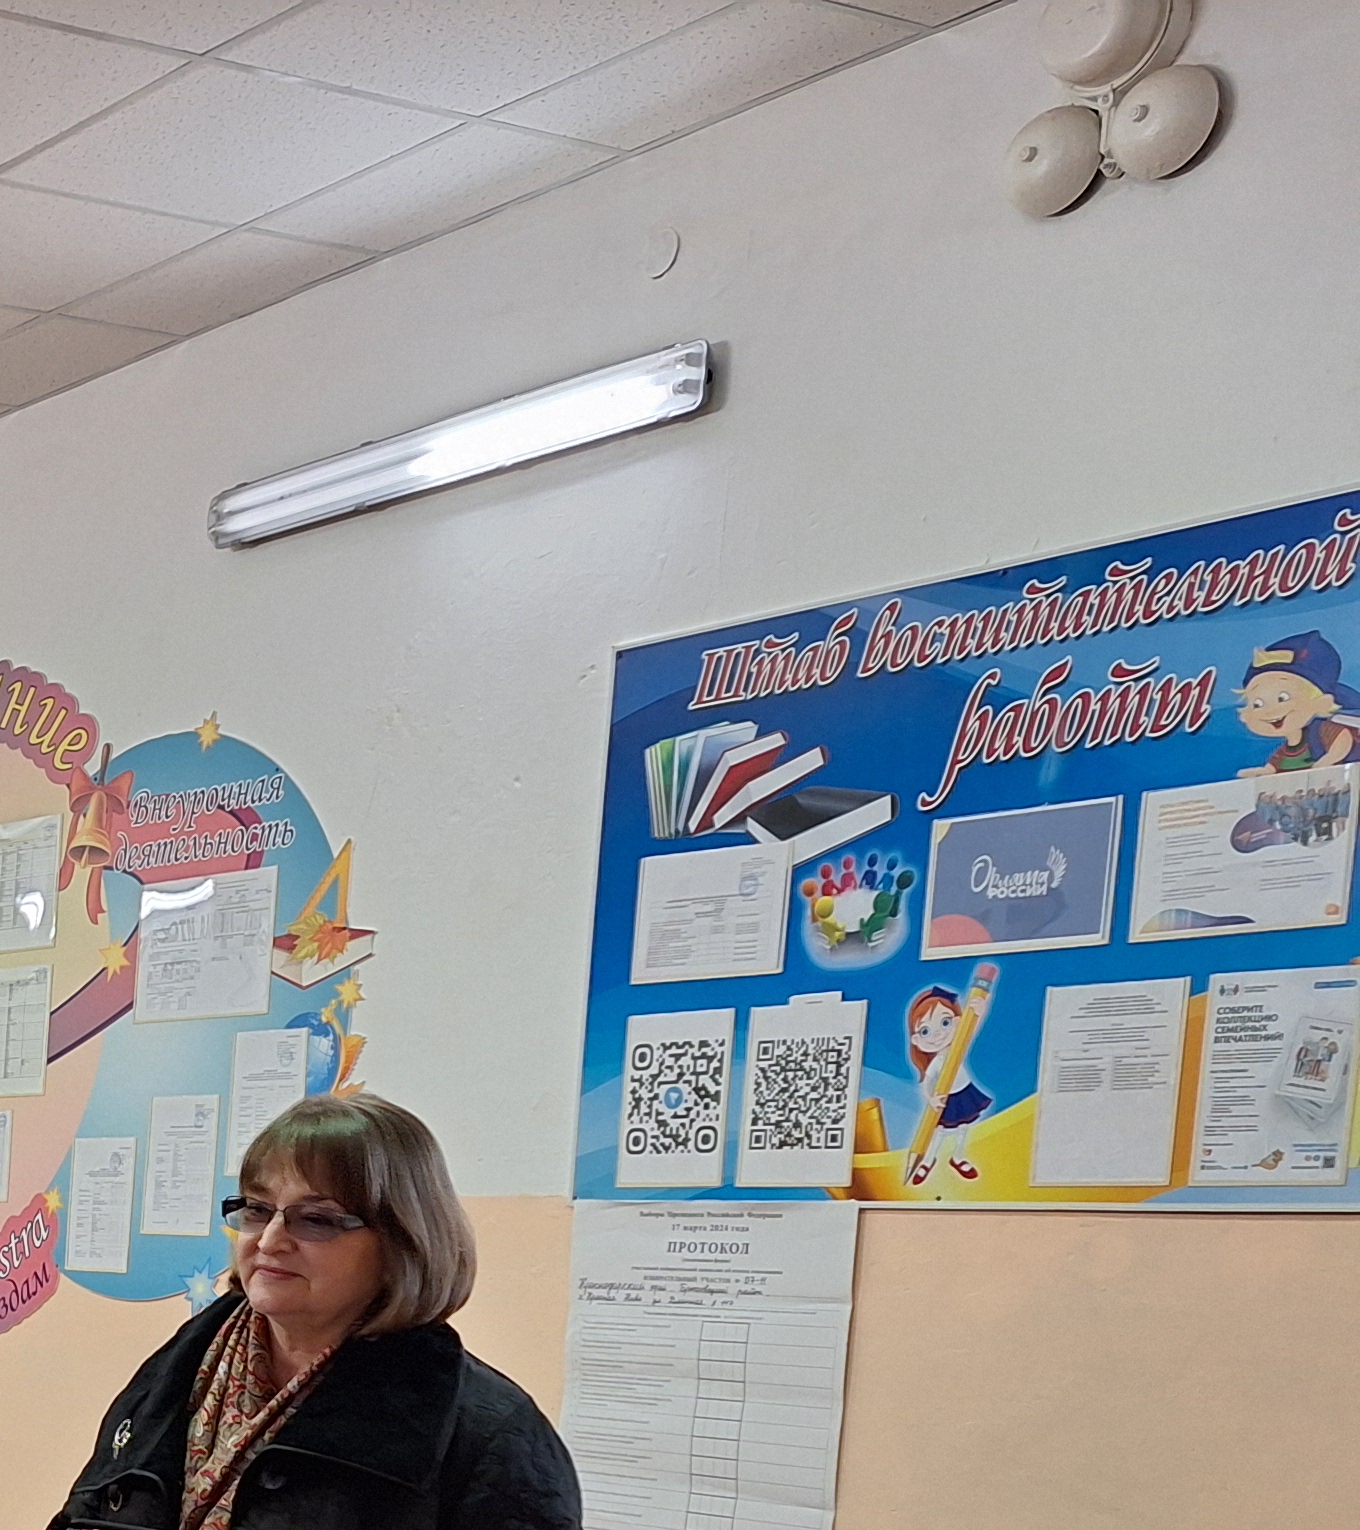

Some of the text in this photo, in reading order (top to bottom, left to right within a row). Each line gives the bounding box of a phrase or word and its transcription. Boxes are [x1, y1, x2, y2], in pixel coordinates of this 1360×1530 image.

[688, 510, 1360, 711] Штаб воспитательной
[917, 657, 1217, 811] работы
[130, 774, 283, 833] Внеурочная
[114, 819, 295, 872] деятельность
[988, 884, 1048, 899] РОССИИ
[1217, 1004, 1264, 1015] СОБЕРИТЕ
[1216, 1014, 1279, 1025] КОЛЛЕКЦИЮ
[1214, 1023, 1268, 1035] СЕМЕЙНЫХ
[671, 1223, 680, 1231] 17
[683, 1225, 707, 1233] марта
[709, 1224, 729, 1232] 2024
[667, 1241, 750, 1255] ПРОТОКОЛ
